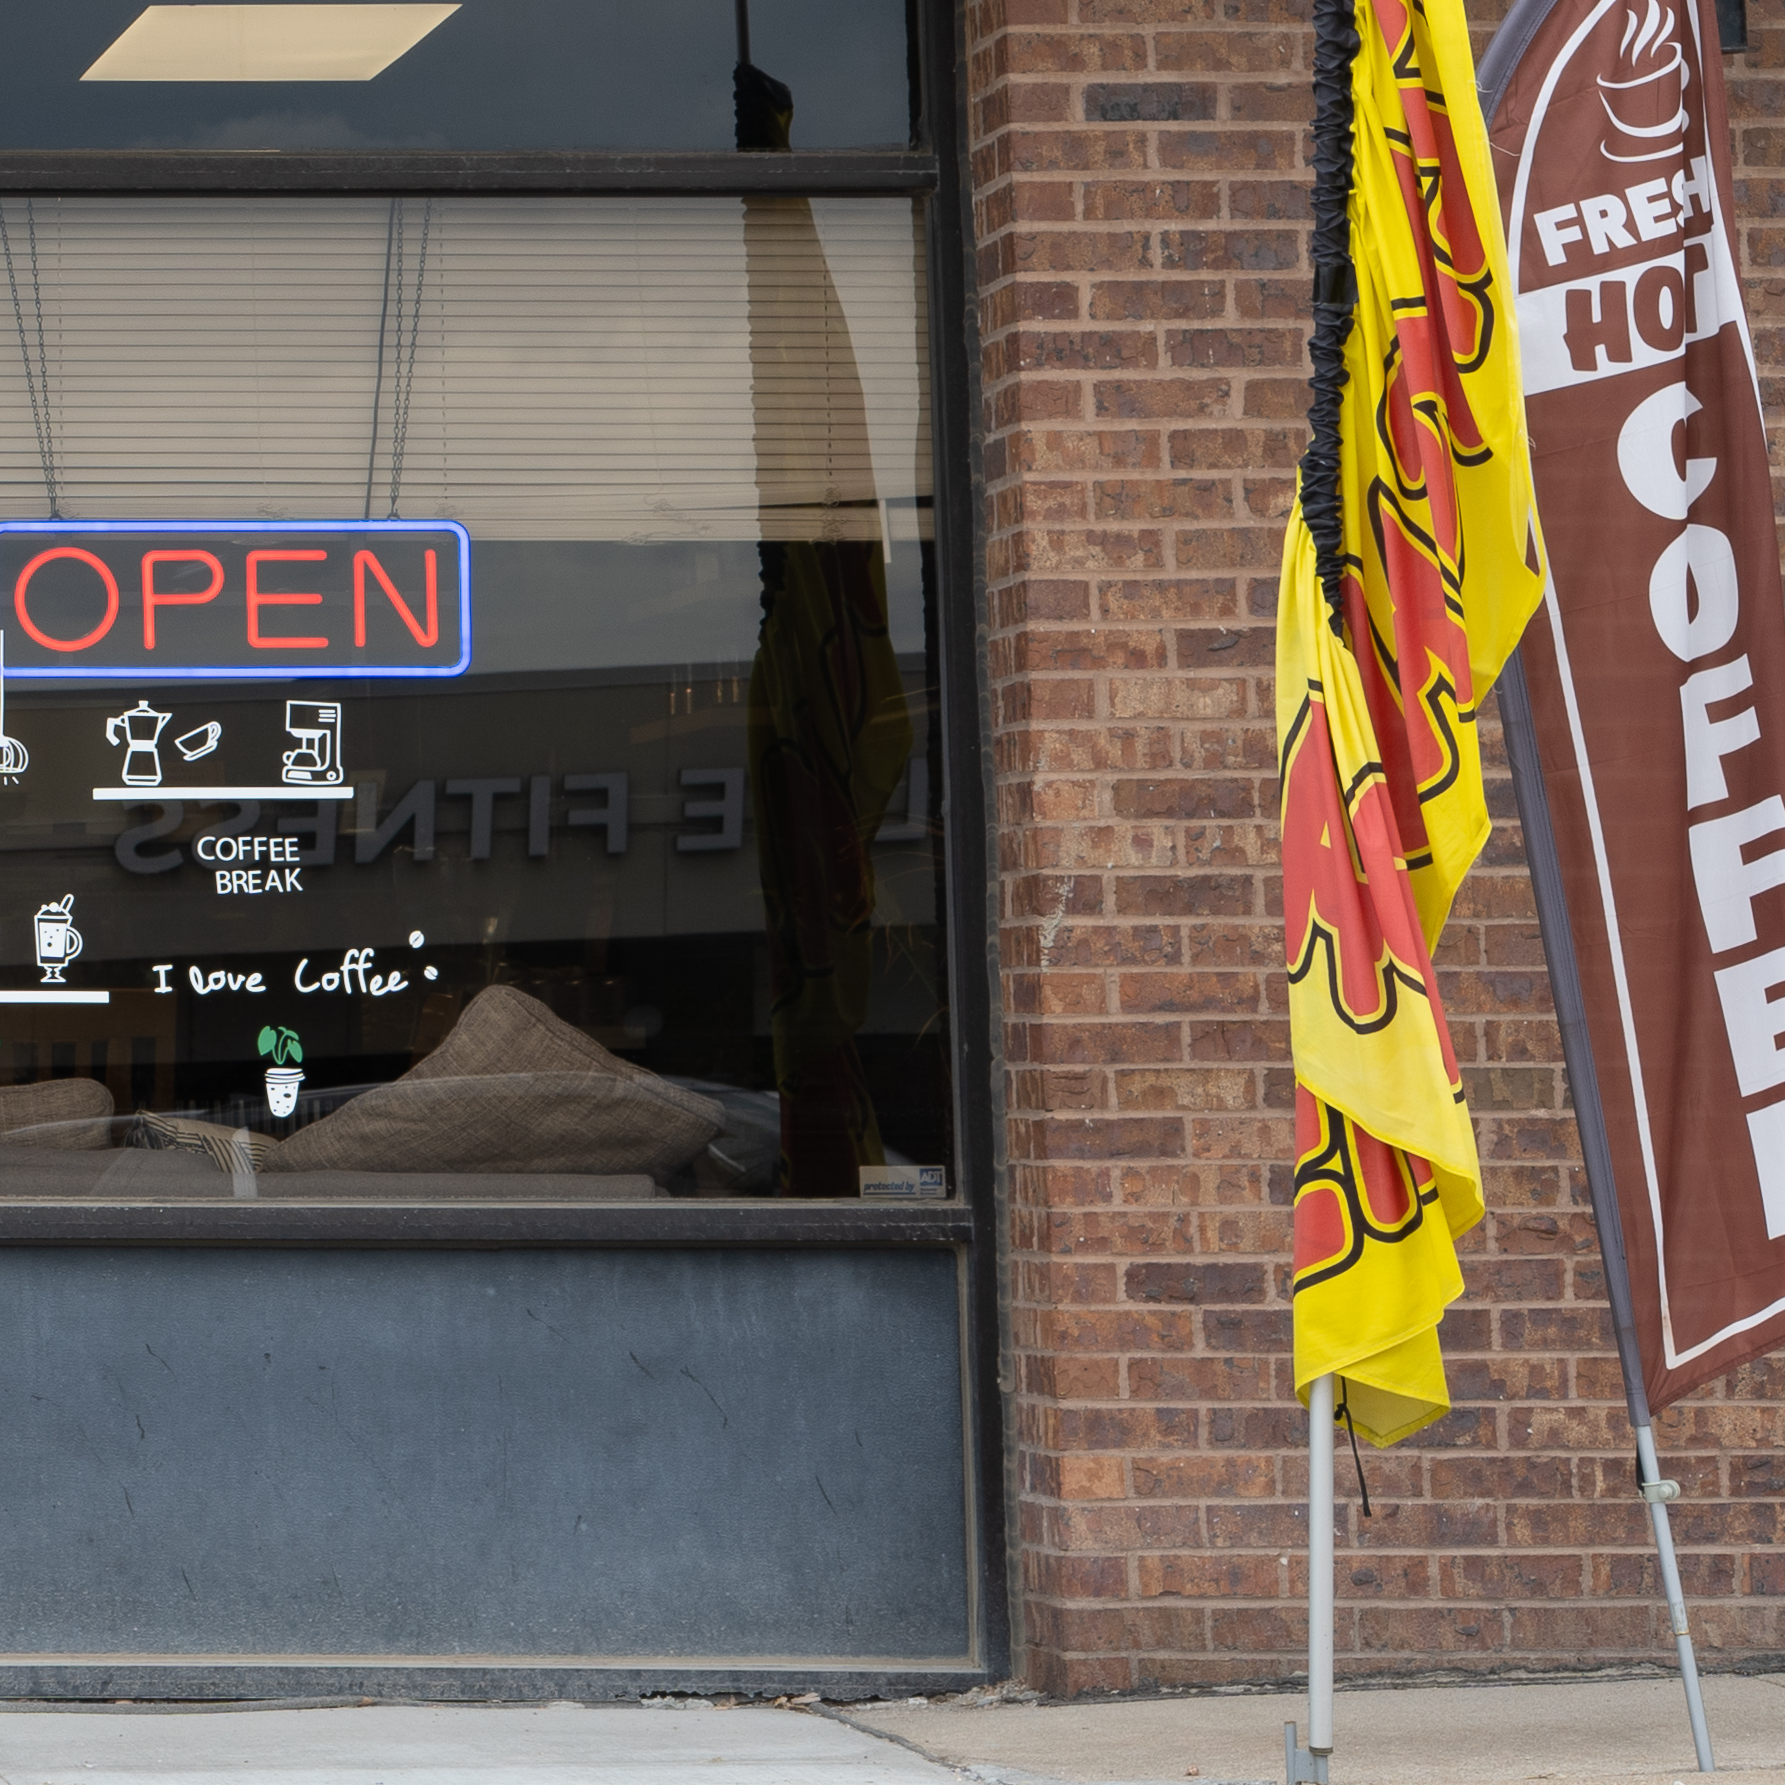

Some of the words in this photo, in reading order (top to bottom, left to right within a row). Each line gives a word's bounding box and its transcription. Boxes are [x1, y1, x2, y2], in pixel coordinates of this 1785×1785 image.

[14, 546, 439, 652] OPEN
[196, 835, 300, 863] COFFEE
[214, 867, 304, 895] BREAK
[152, 963, 174, 994] I
[189, 964, 267, 995] love
[294, 948, 410, 997] Coffee
[864, 1181, 905, 1192] protected
[906, 1181, 915, 1192] by
[920, 1171, 942, 1183] ADT
